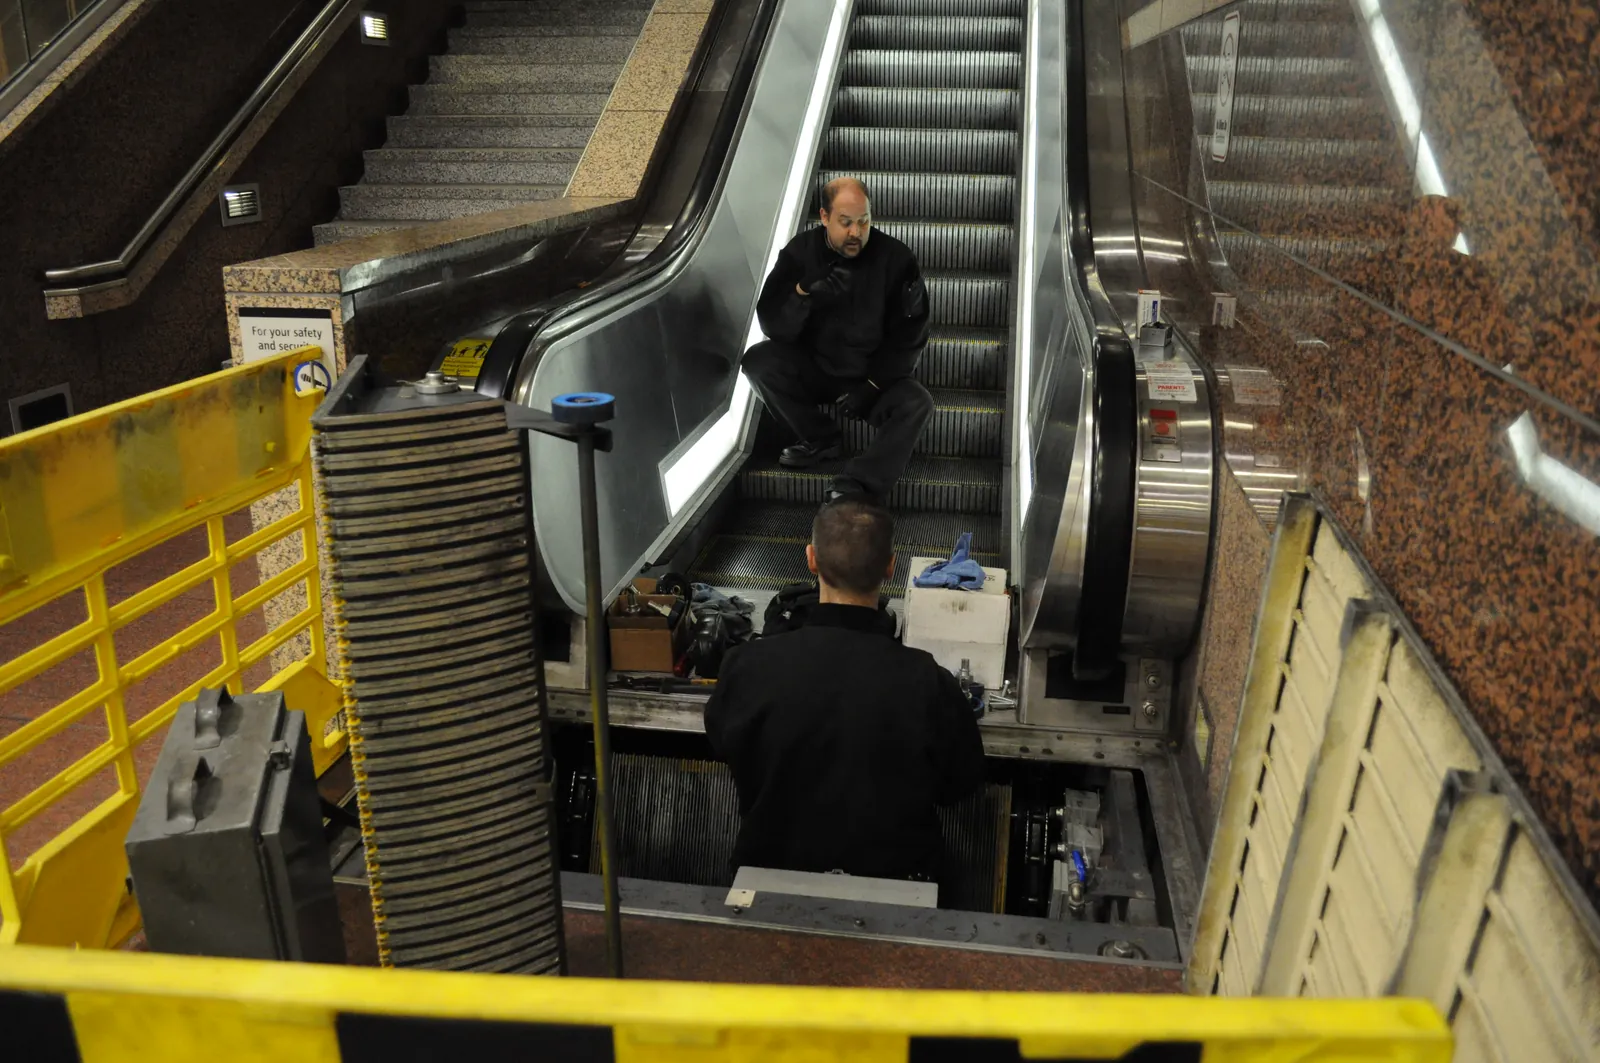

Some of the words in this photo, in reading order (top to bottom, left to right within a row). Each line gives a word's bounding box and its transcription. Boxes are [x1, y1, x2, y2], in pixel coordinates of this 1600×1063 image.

[252, 326, 267, 336] For
[269, 328, 290, 339] your
[293, 327, 322, 340] safety
[258, 340, 276, 350] and
[279, 341, 319, 351] securi
